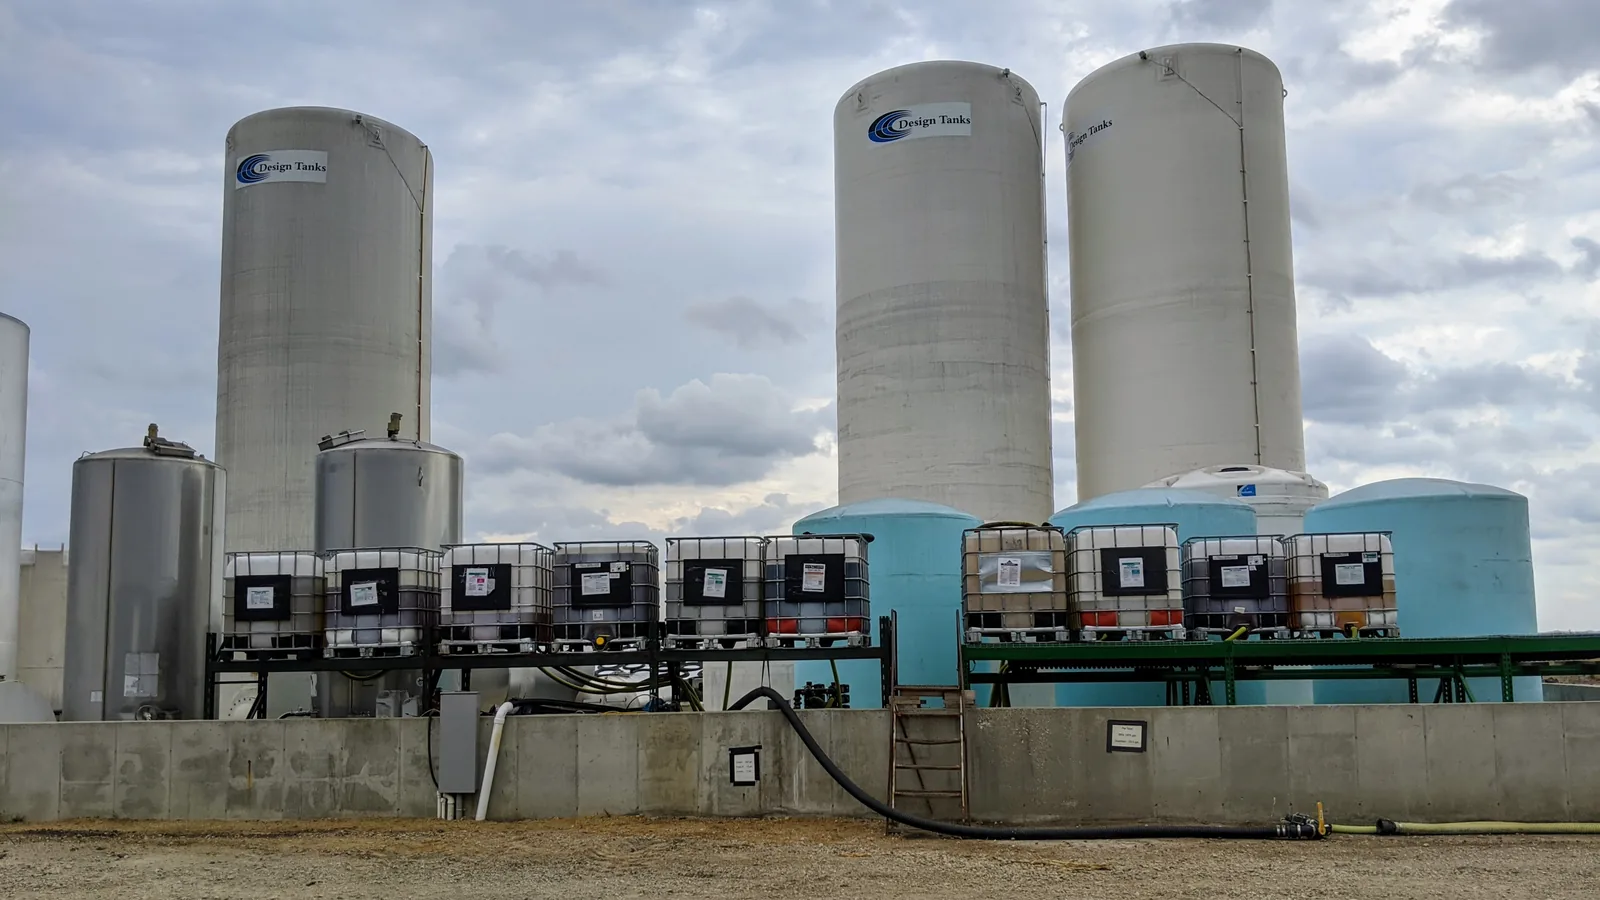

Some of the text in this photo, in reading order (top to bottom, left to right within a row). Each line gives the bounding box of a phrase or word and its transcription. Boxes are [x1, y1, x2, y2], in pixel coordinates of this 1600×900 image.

[899, 115, 971, 129] Design Tanks
[1069, 120, 1113, 152] Design Tanks
[259, 161, 327, 173] Design Tanks
